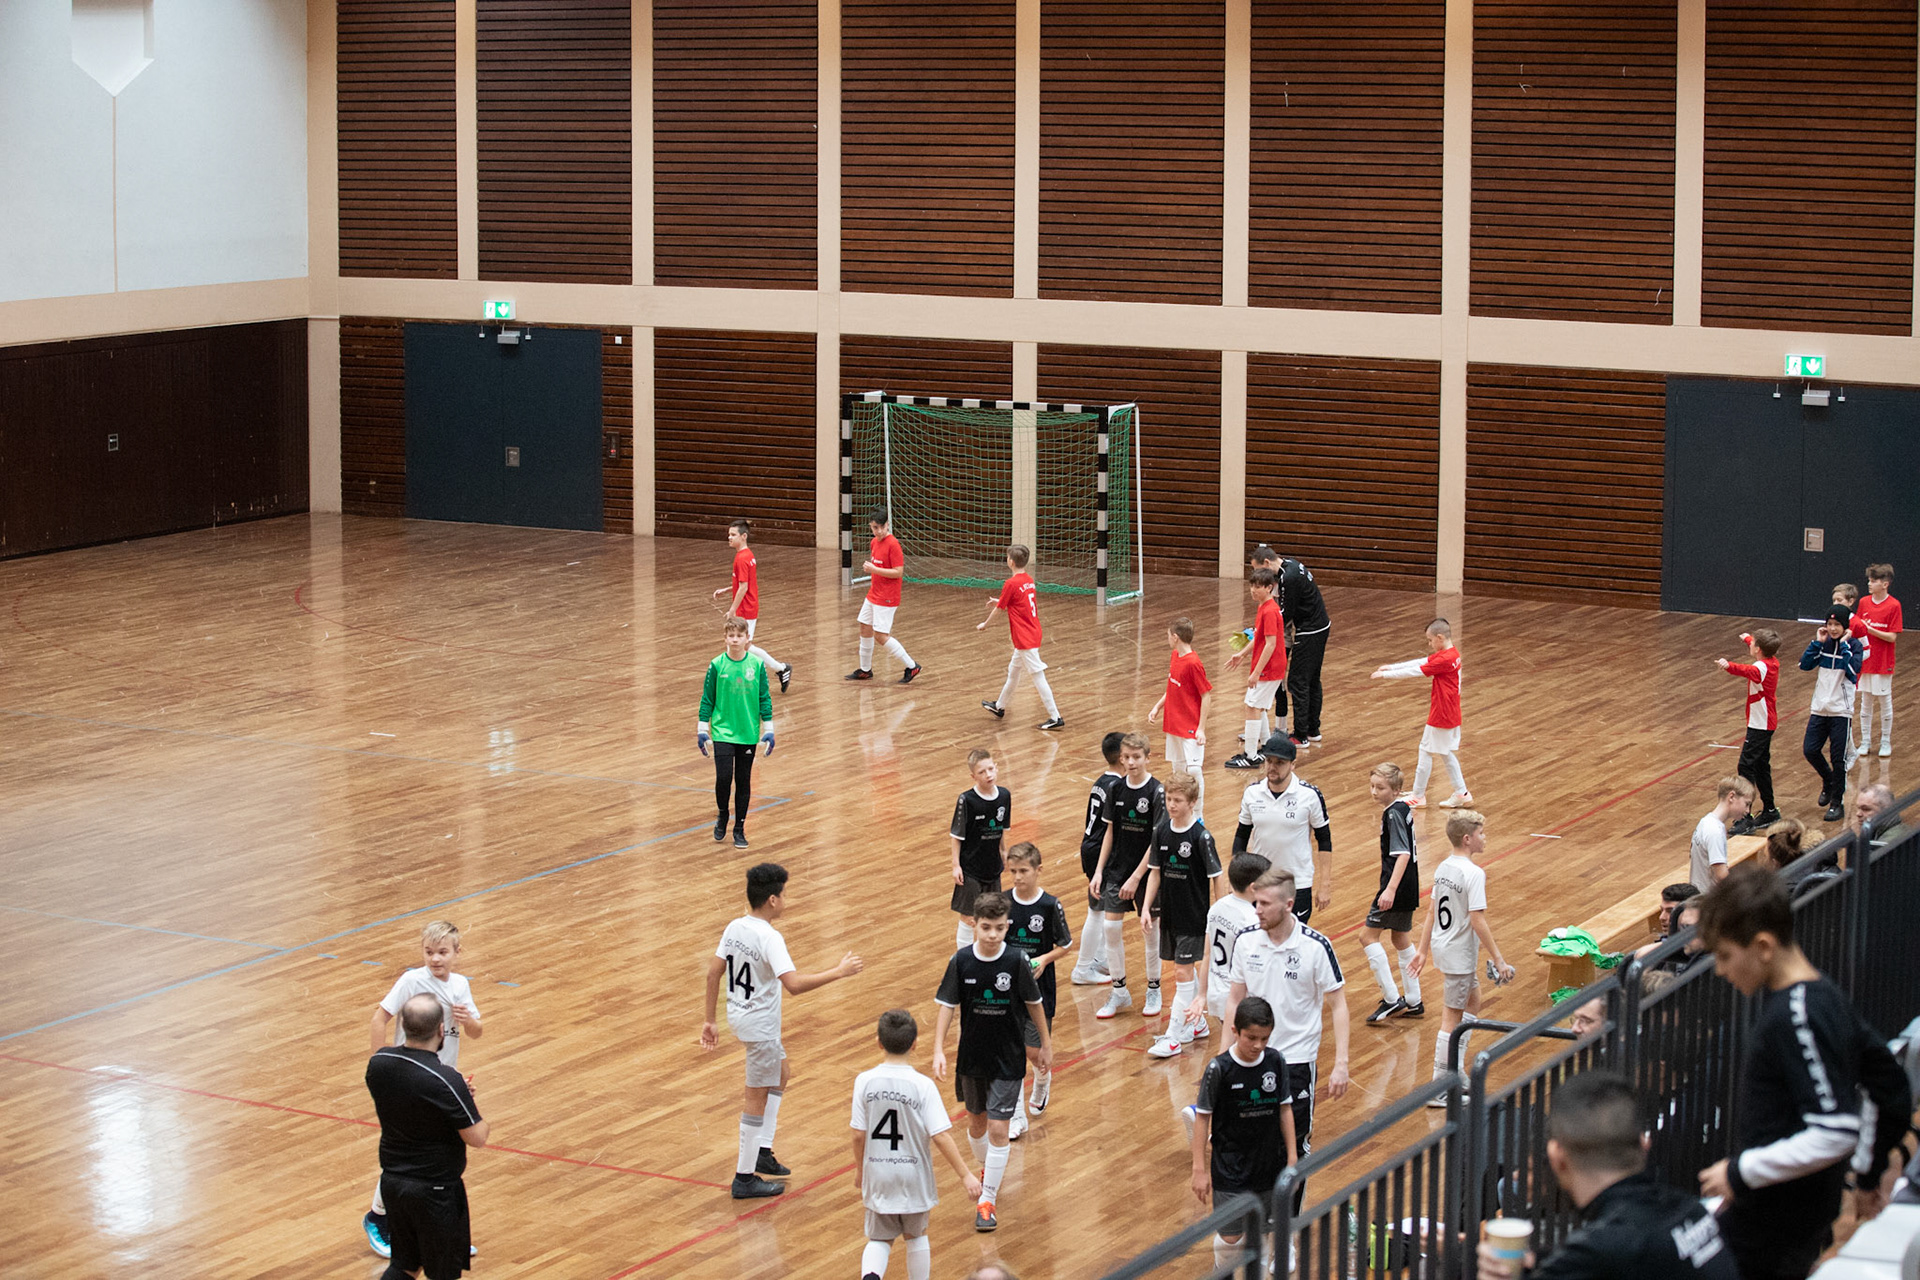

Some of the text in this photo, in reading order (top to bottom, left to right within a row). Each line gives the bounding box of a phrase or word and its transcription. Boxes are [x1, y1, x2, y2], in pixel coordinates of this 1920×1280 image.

[1028, 593, 1036, 617] 5
[1285, 811, 1296, 819] CR
[1438, 895, 1452, 930] 6
[1213, 928, 1228, 967] 5
[726, 954, 755, 1000] 14
[1284, 971, 1298, 980] MB
[866, 1090, 919, 1110] SK RODGAU
[871, 1108, 904, 1151] 4
